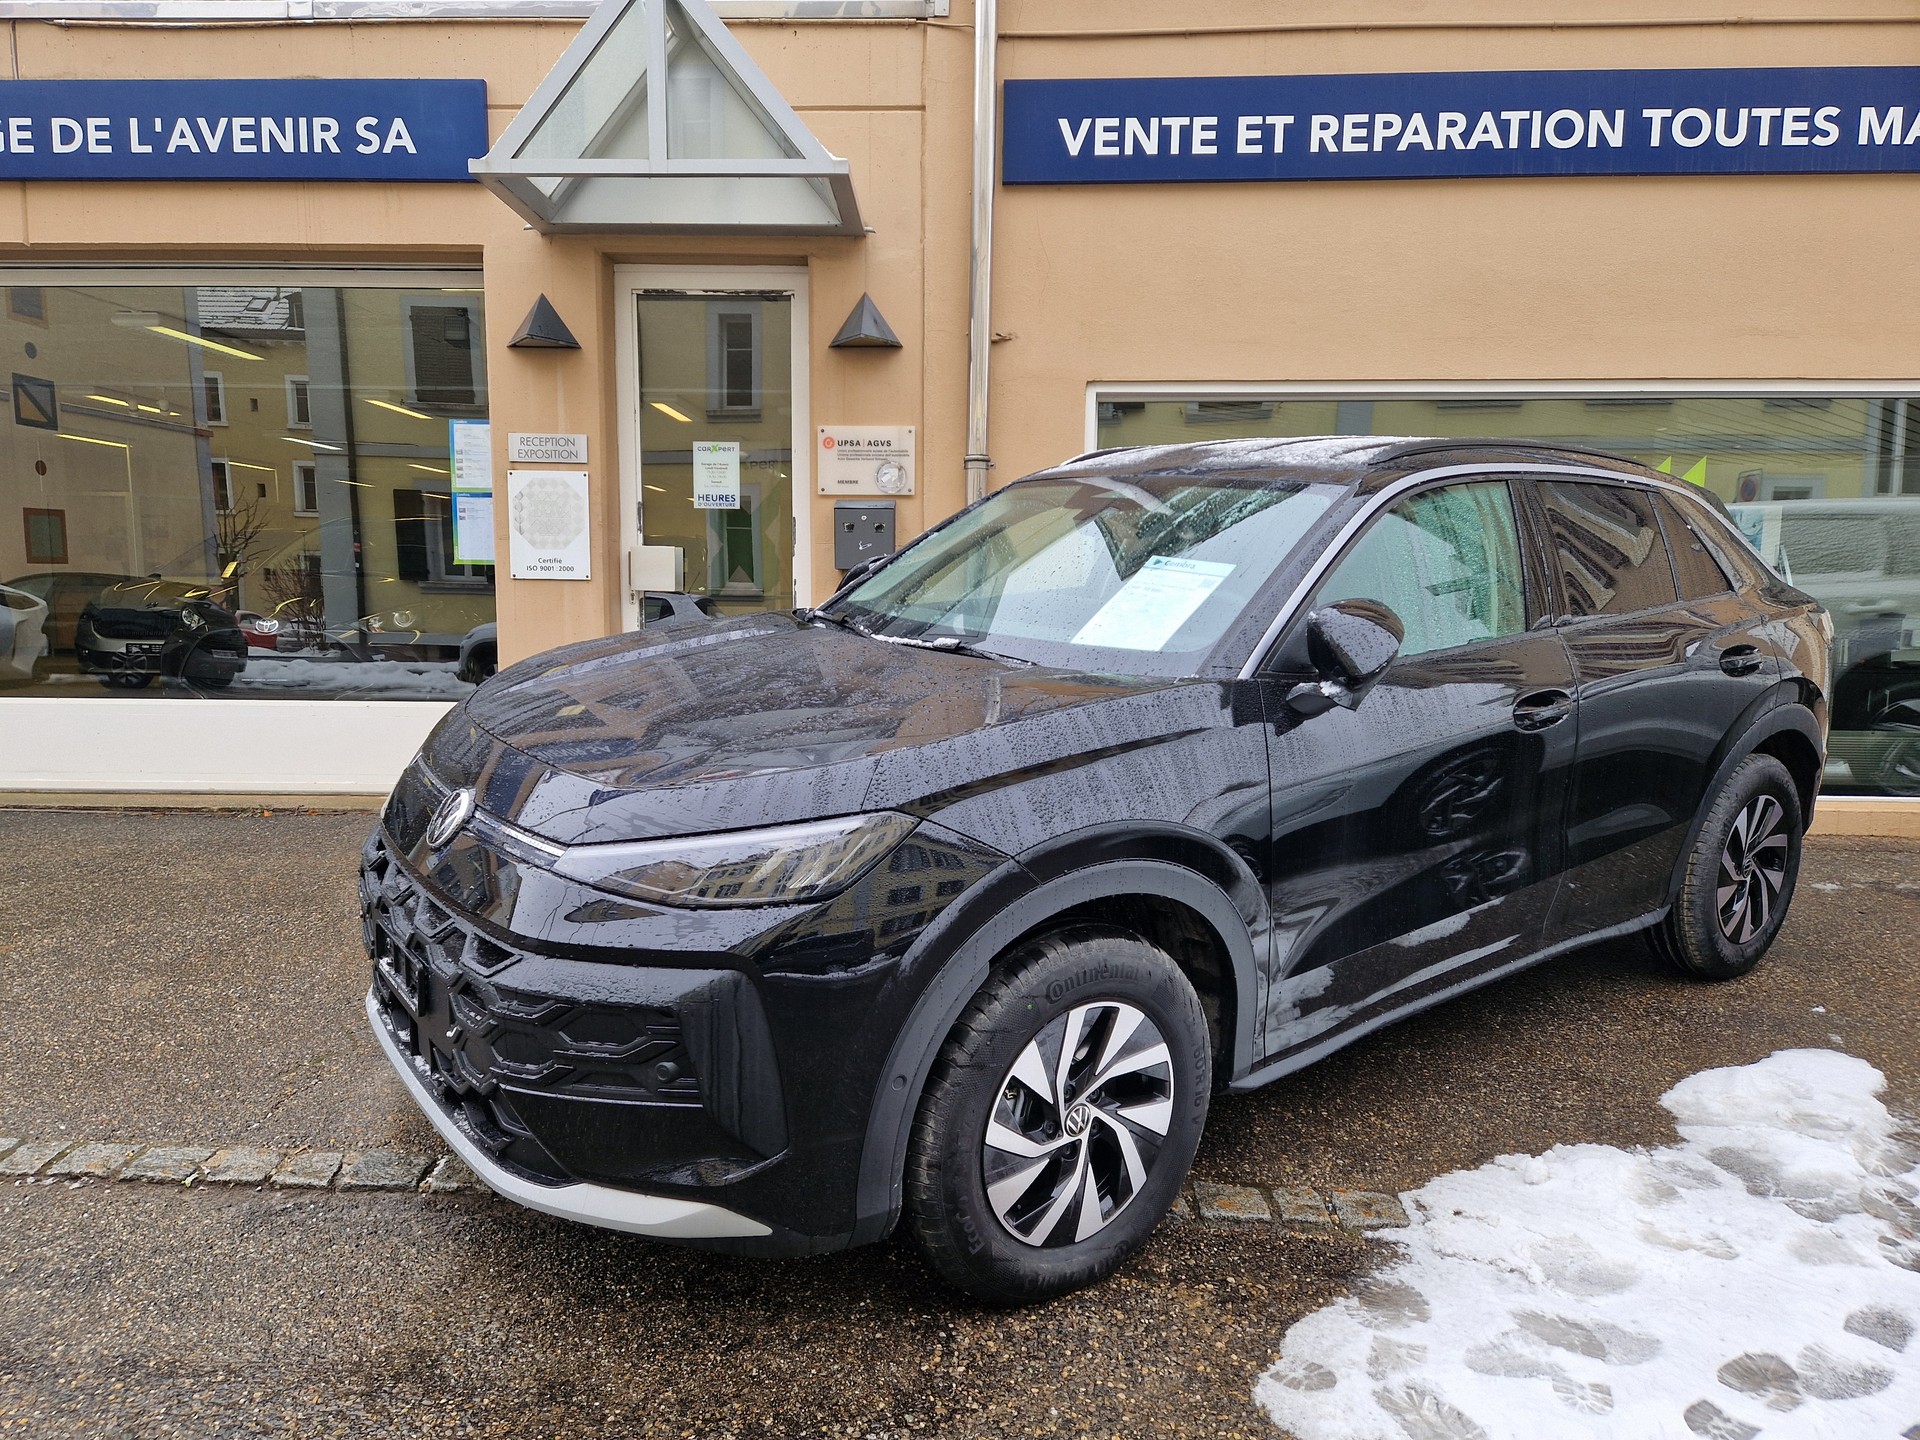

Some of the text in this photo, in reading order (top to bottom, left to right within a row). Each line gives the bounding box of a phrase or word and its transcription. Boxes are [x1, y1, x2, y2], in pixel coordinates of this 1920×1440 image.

[52, 116, 113, 154] DE
[129, 116, 341, 154] L'AVENIR
[355, 116, 418, 154] SA
[1058, 115, 1219, 156] VENTE
[1236, 114, 1295, 155] ET
[1309, 108, 1625, 154] REPARATION
[1642, 106, 1841, 149] TOUTES
[519, 436, 576, 448] RECEPTION
[837, 439, 892, 447] UPSA AGVS
[517, 448, 579, 460] EXPOSITION
[697, 493, 736, 502] HEURES
[1045, 960, 1140, 1004] Continental
